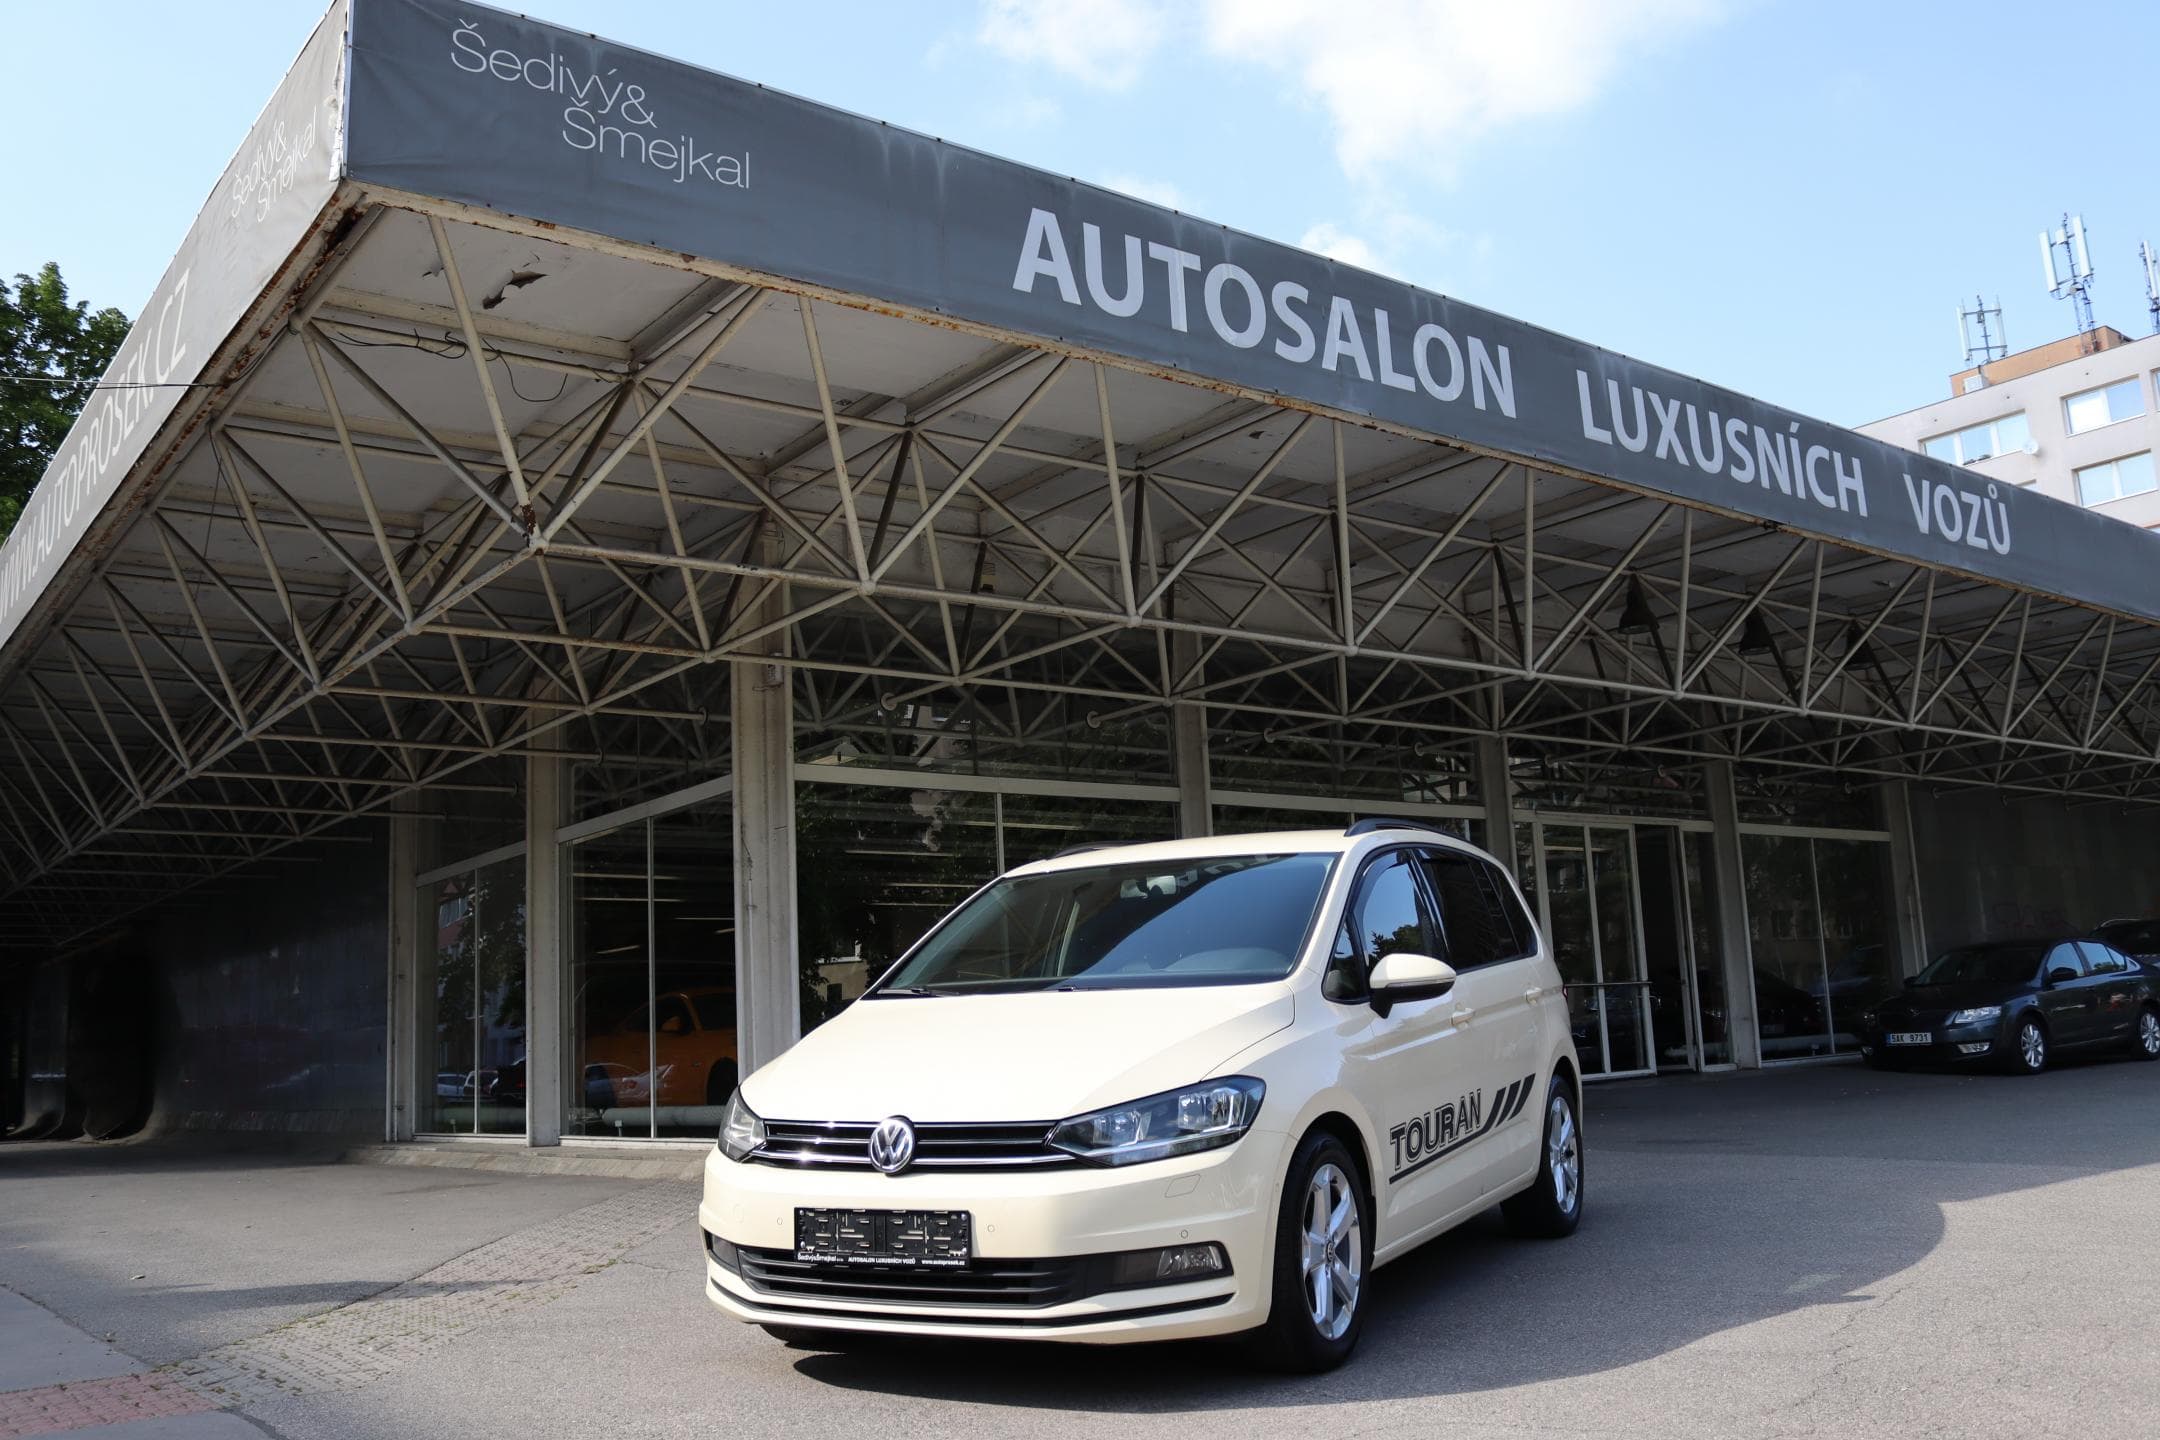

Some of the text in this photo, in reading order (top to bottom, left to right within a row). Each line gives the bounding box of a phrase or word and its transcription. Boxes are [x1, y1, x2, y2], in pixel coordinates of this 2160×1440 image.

[450, 17, 658, 129] Šedivý&
[562, 96, 750, 189] Šmejkal
[1012, 207, 2012, 555] AUTOSALON LUXUSNÍCH VOZŮ
[1390, 1088, 1482, 1171] TOURAN
